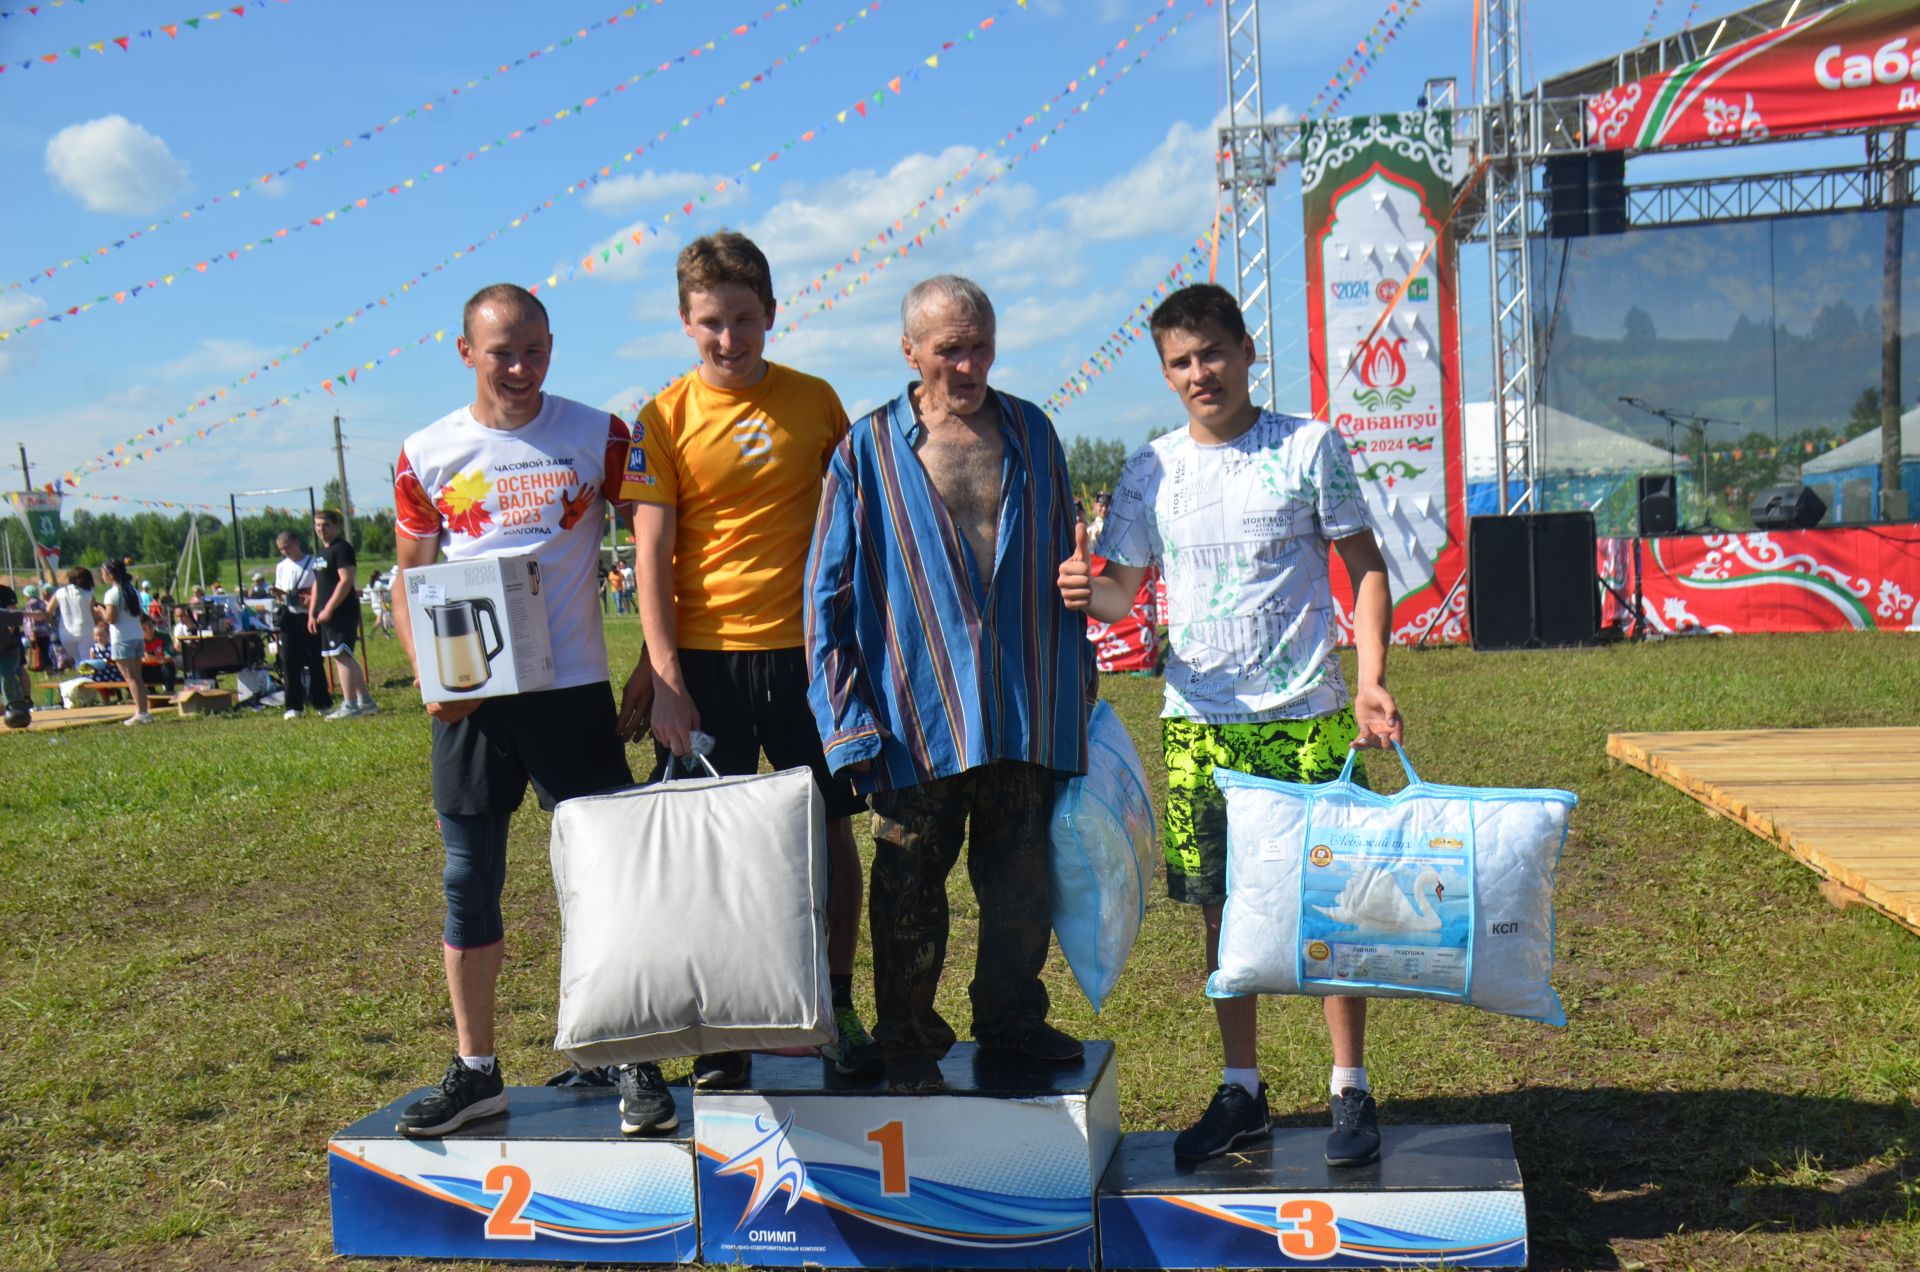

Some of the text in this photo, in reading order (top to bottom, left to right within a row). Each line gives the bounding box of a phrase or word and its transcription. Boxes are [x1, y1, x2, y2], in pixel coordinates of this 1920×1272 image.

[1337, 280, 1370, 299] 2024
[1335, 405, 1437, 437] Сабантуй
[1371, 439, 1403, 452] 2024
[494, 459, 544, 472] ЧАСОВОЙ
[496, 467, 579, 494] ОСЕННИЙ
[498, 489, 556, 511] ВАЛЬС
[502, 508, 541, 528] 2023
[1242, 515, 1292, 525] STORY BEGIN
[1492, 922, 1518, 934] КСП
[866, 1121, 909, 1197] 1
[484, 1165, 535, 1239] 2
[748, 1230, 796, 1243] ОЛИМП
[1278, 1199, 1338, 1258] 3
